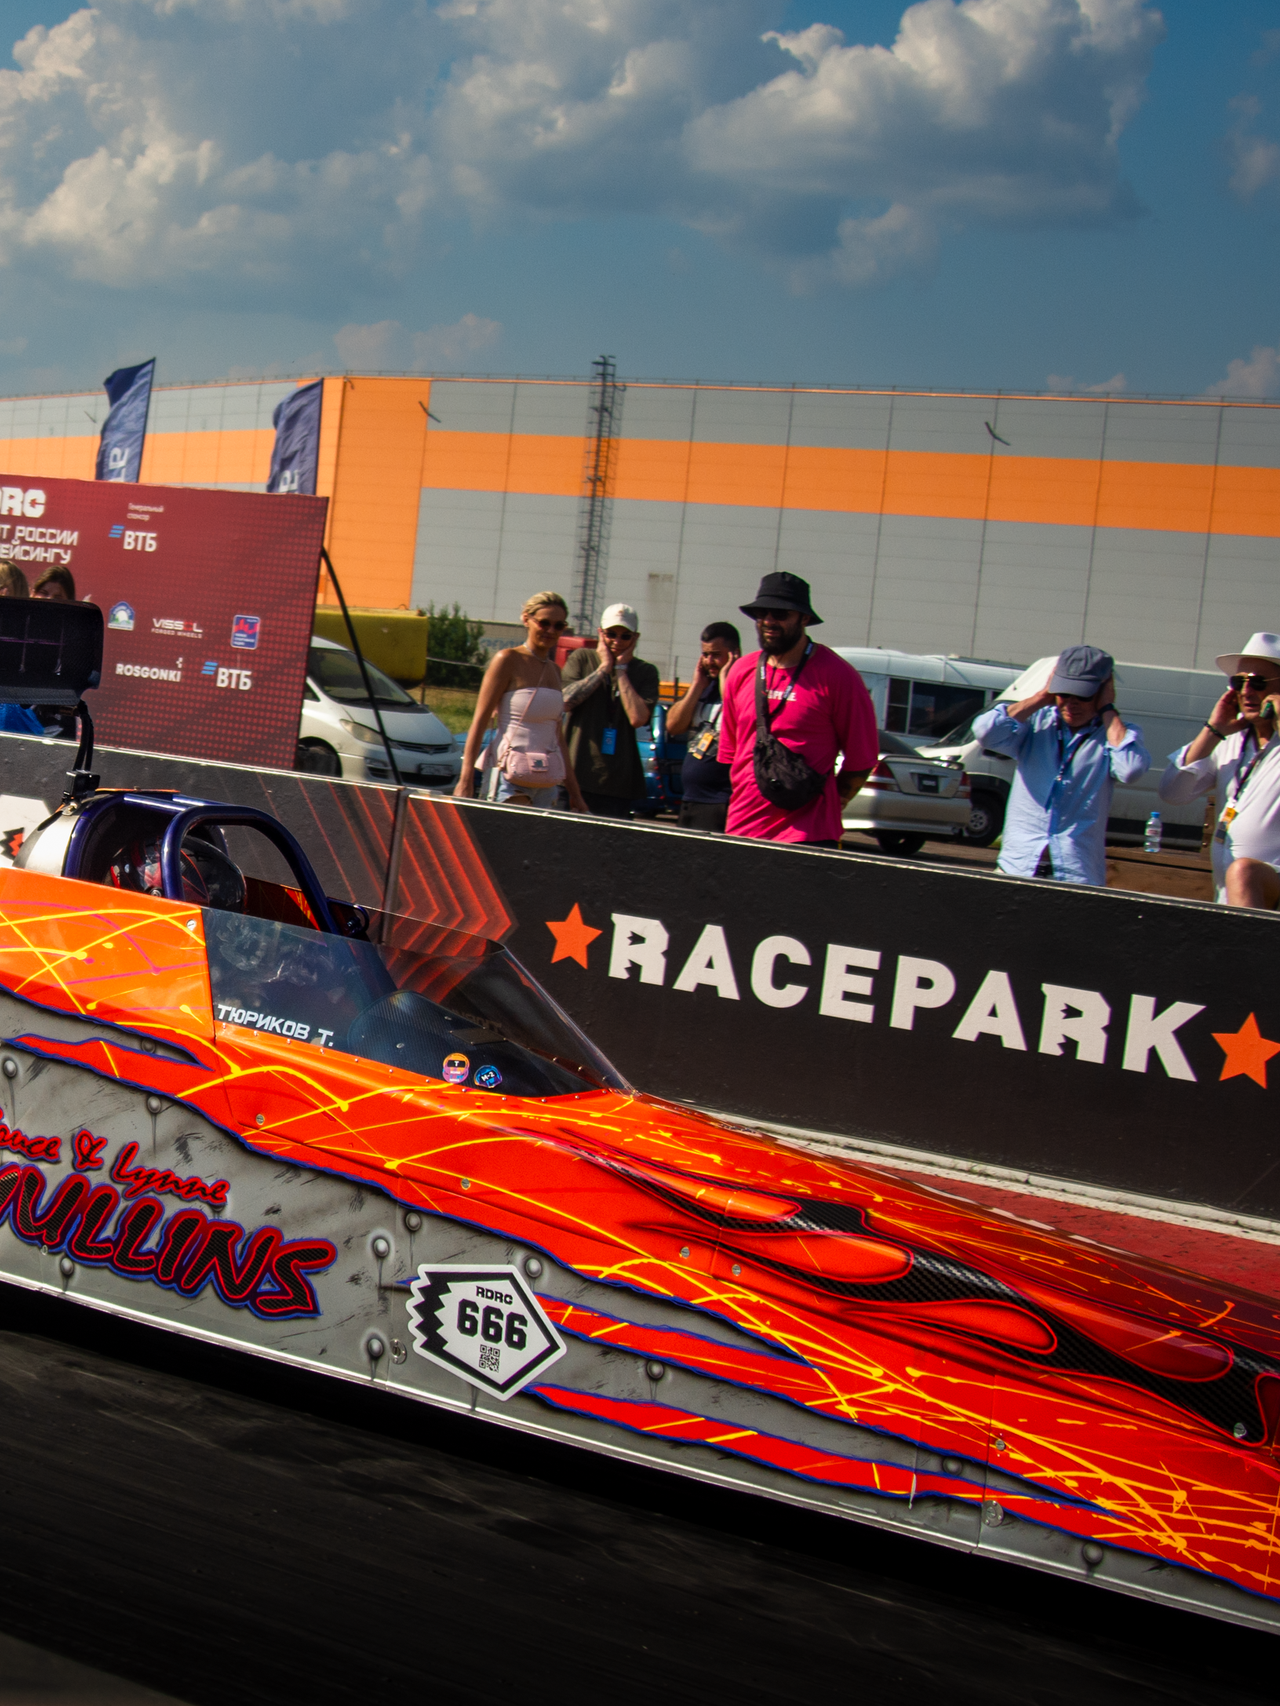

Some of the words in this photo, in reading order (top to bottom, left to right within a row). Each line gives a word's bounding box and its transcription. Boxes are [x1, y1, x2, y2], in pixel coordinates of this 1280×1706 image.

[15, 525, 79, 546] РОССИИ
[123, 530, 158, 552] ВТБ
[115, 663, 182, 682] ROSGONKI
[216, 667, 252, 691] ВТБ
[608, 912, 1207, 1083] RACEPARK
[218, 1004, 310, 1040] ТЮРИКОВ
[318, 1028, 334, 1047] Т.
[73, 1129, 108, 1170] &
[111, 1141, 230, 1204] Lynne
[476, 1286, 513, 1305] RDRC
[457, 1298, 528, 1351] 666
